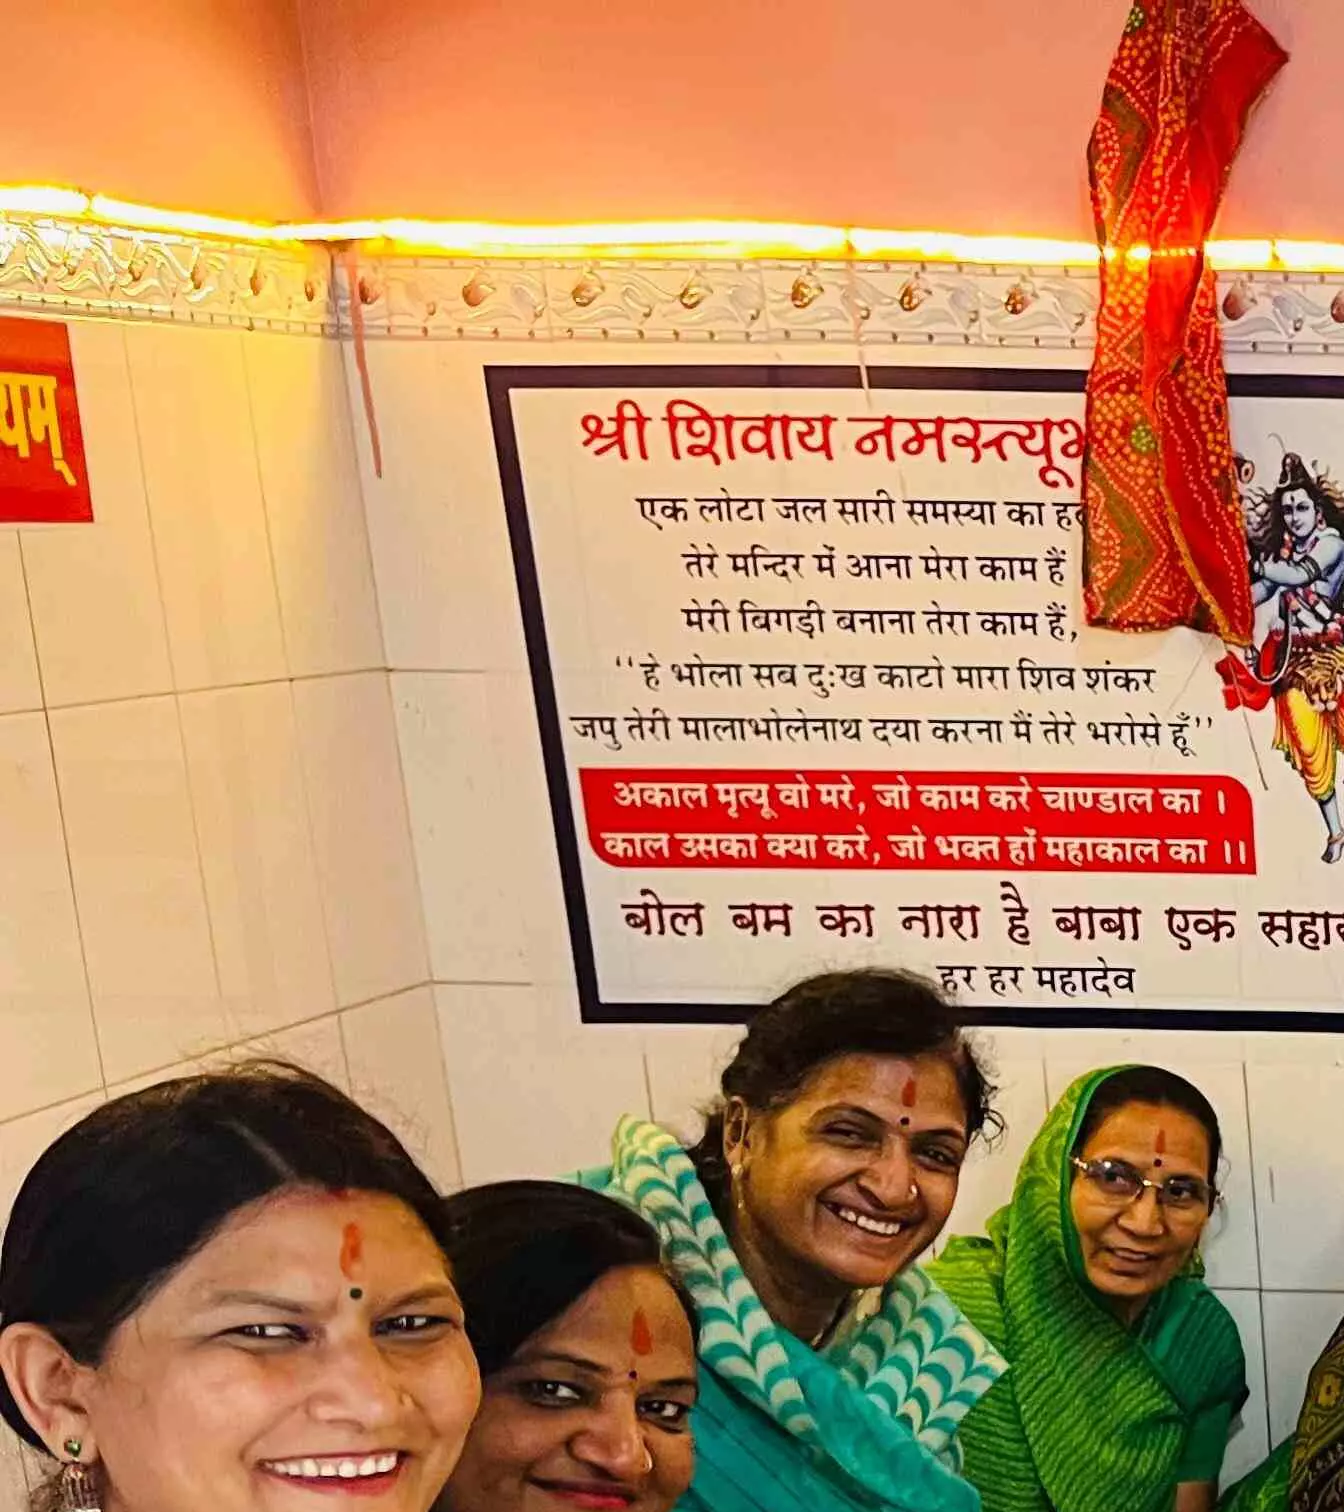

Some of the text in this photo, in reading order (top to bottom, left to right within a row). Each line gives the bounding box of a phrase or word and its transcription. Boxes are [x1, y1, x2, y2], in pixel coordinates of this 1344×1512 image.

[581, 400, 651, 460] श्री
[662, 400, 837, 466] शिवाय
[1016, 657, 1075, 692] शिव
